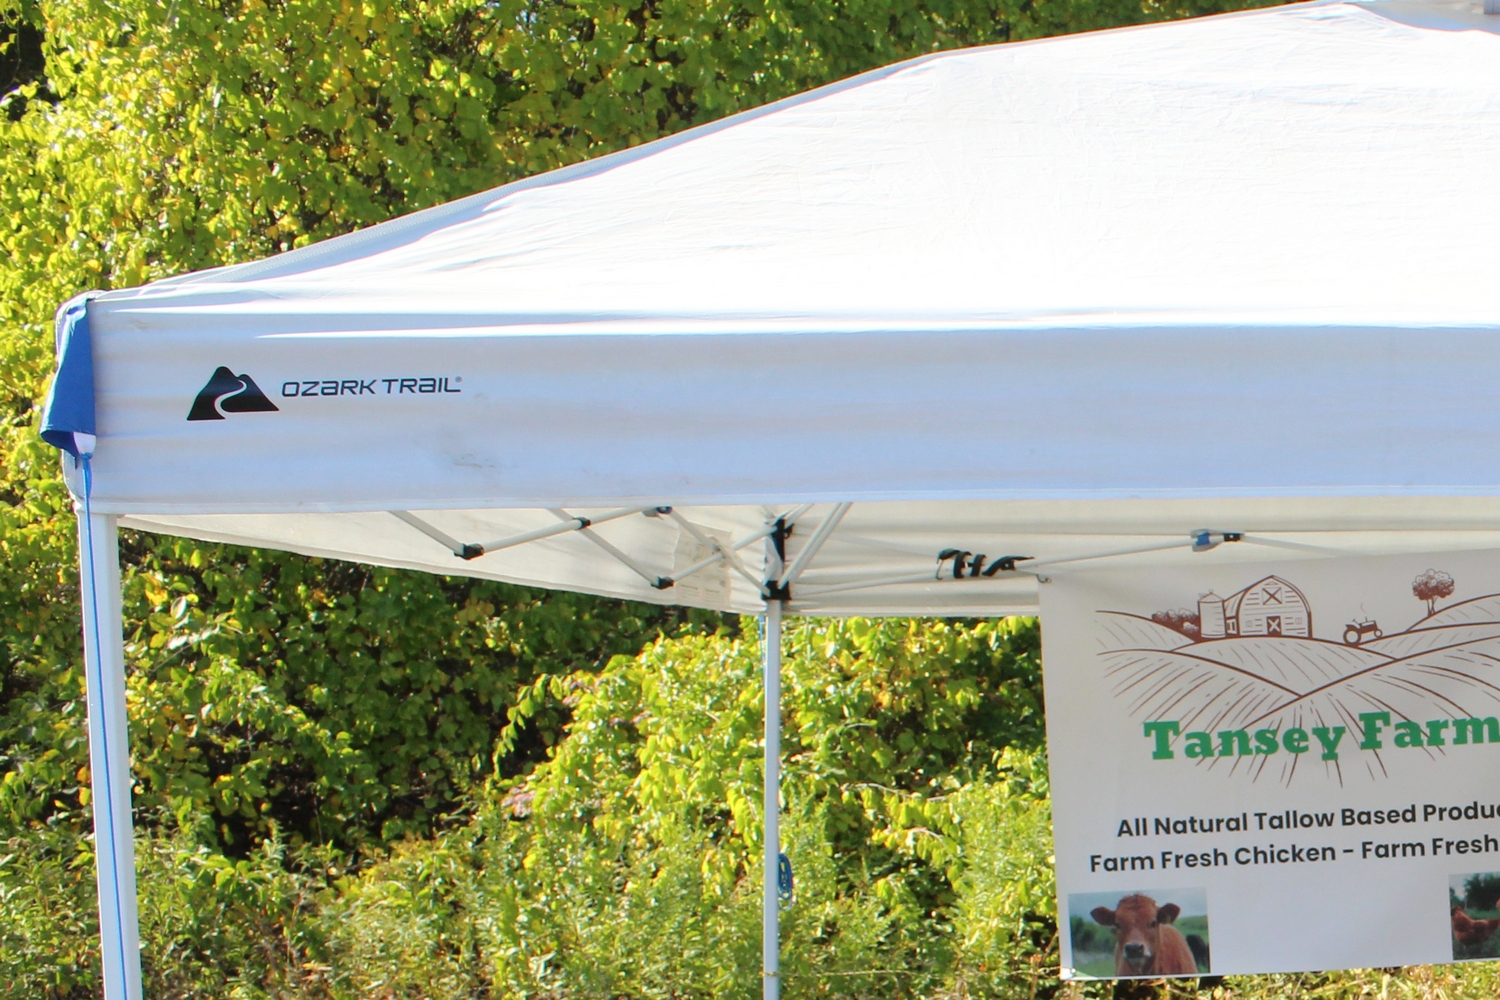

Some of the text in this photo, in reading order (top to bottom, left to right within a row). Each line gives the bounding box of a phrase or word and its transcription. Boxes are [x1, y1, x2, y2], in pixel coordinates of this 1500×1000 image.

[281, 377, 462, 398] OZARK TRAIL
[1143, 720, 1347, 762] Tansey
[1117, 817, 1149, 838] All
[1154, 812, 1249, 836] Natural
[1253, 809, 1336, 831] Tallow
[1341, 804, 1417, 827] Based
[1090, 854, 1155, 873] Farm
[1161, 848, 1229, 869] Fresh
[1234, 843, 1337, 866] Chicken
[1361, 841, 1426, 860] Farm
[1432, 834, 1499, 856] Fresh
